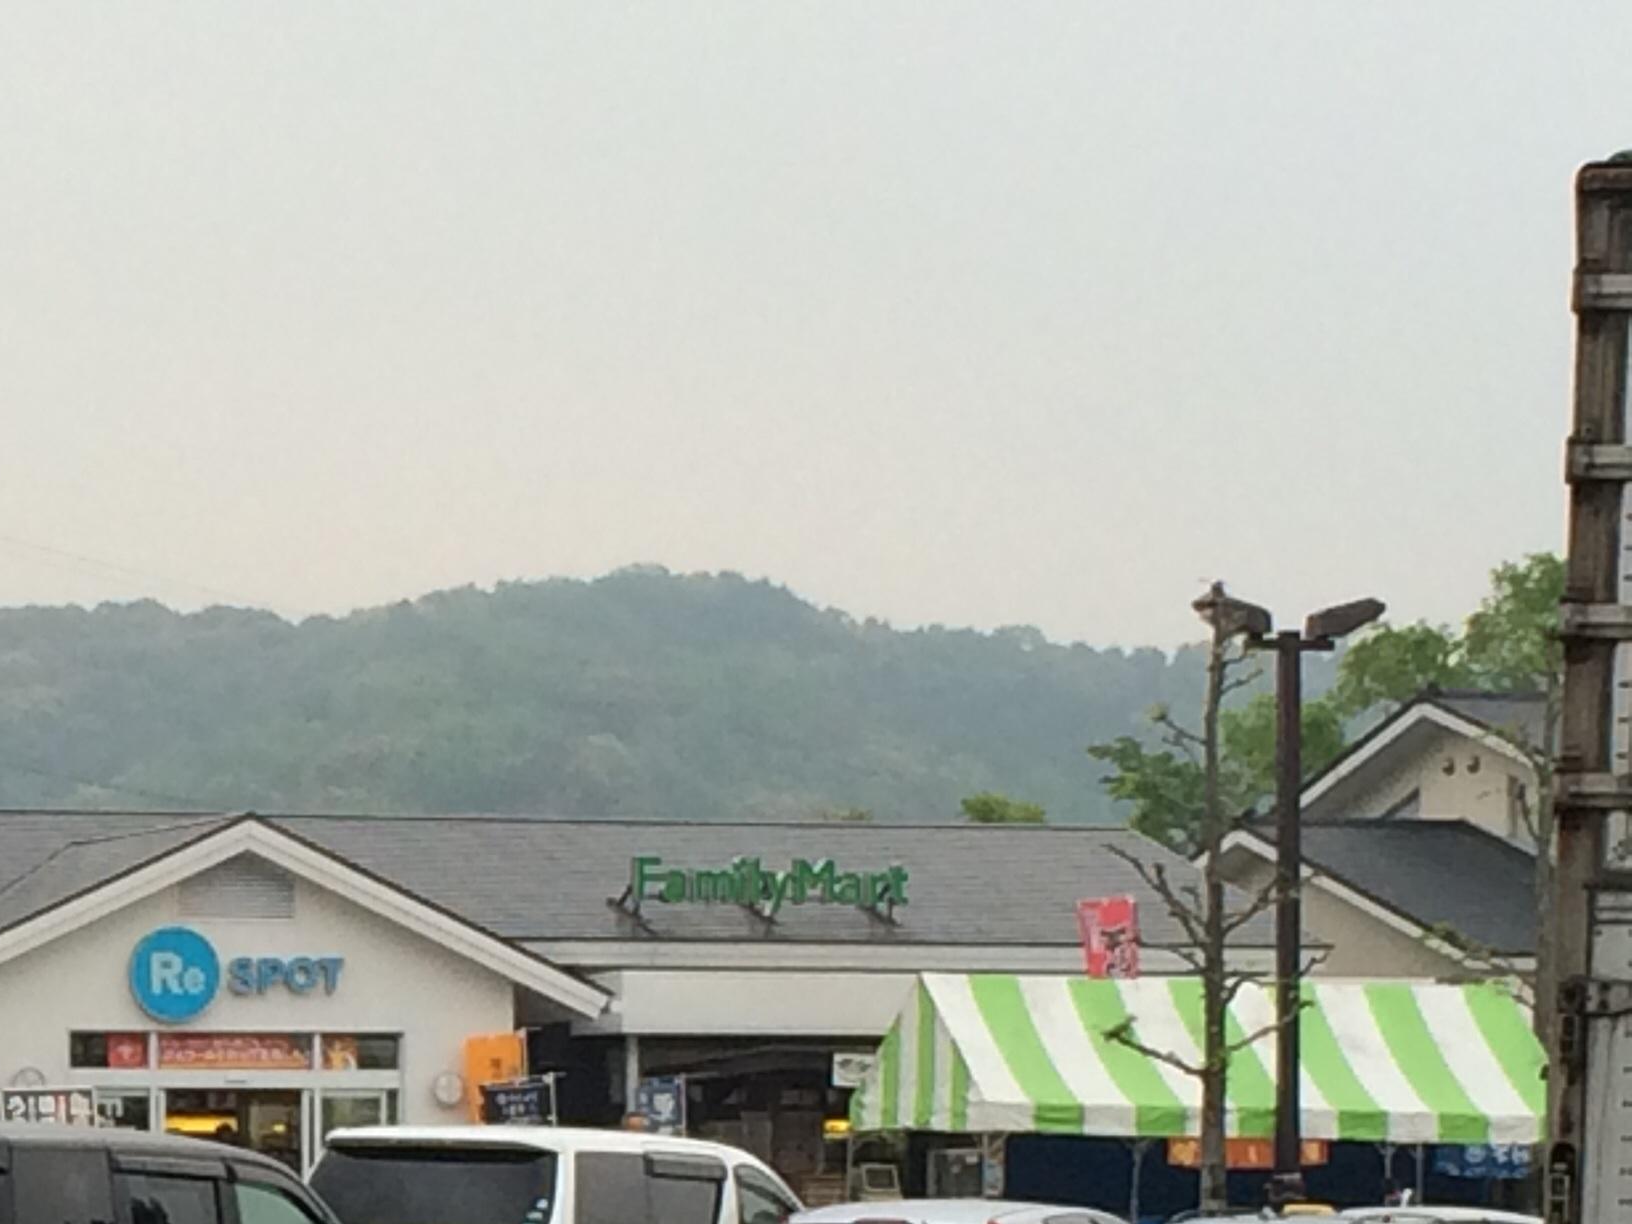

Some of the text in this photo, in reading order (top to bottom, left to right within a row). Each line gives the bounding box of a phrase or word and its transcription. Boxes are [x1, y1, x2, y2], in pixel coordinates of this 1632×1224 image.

[632, 856, 909, 915] FamilyMart
[149, 951, 345, 996] Re SPOT
